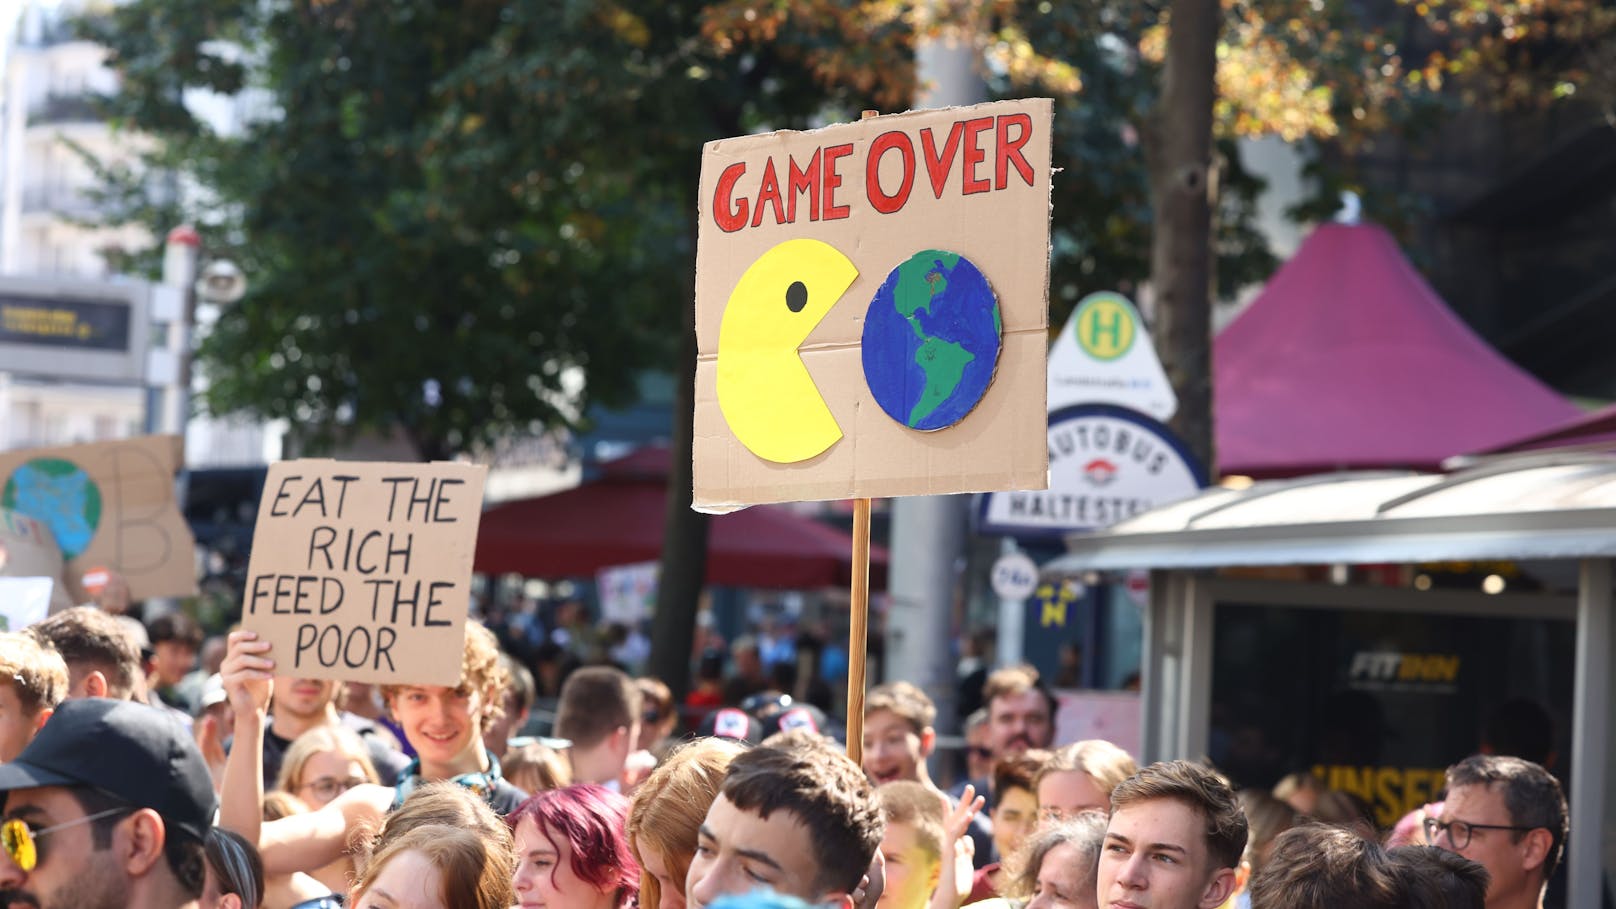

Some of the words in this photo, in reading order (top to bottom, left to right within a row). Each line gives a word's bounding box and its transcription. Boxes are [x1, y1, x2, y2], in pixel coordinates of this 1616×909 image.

[713, 143, 854, 233] GAME
[866, 113, 1035, 214] OVER
[1091, 310, 1121, 348] H
[270, 475, 360, 519] EAT
[382, 477, 465, 523] THE
[1009, 494, 1153, 521] HALTESTE
[308, 526, 413, 574] RICH
[250, 574, 345, 614] FEED
[363, 579, 456, 627] THE
[295, 624, 398, 672] POOR
